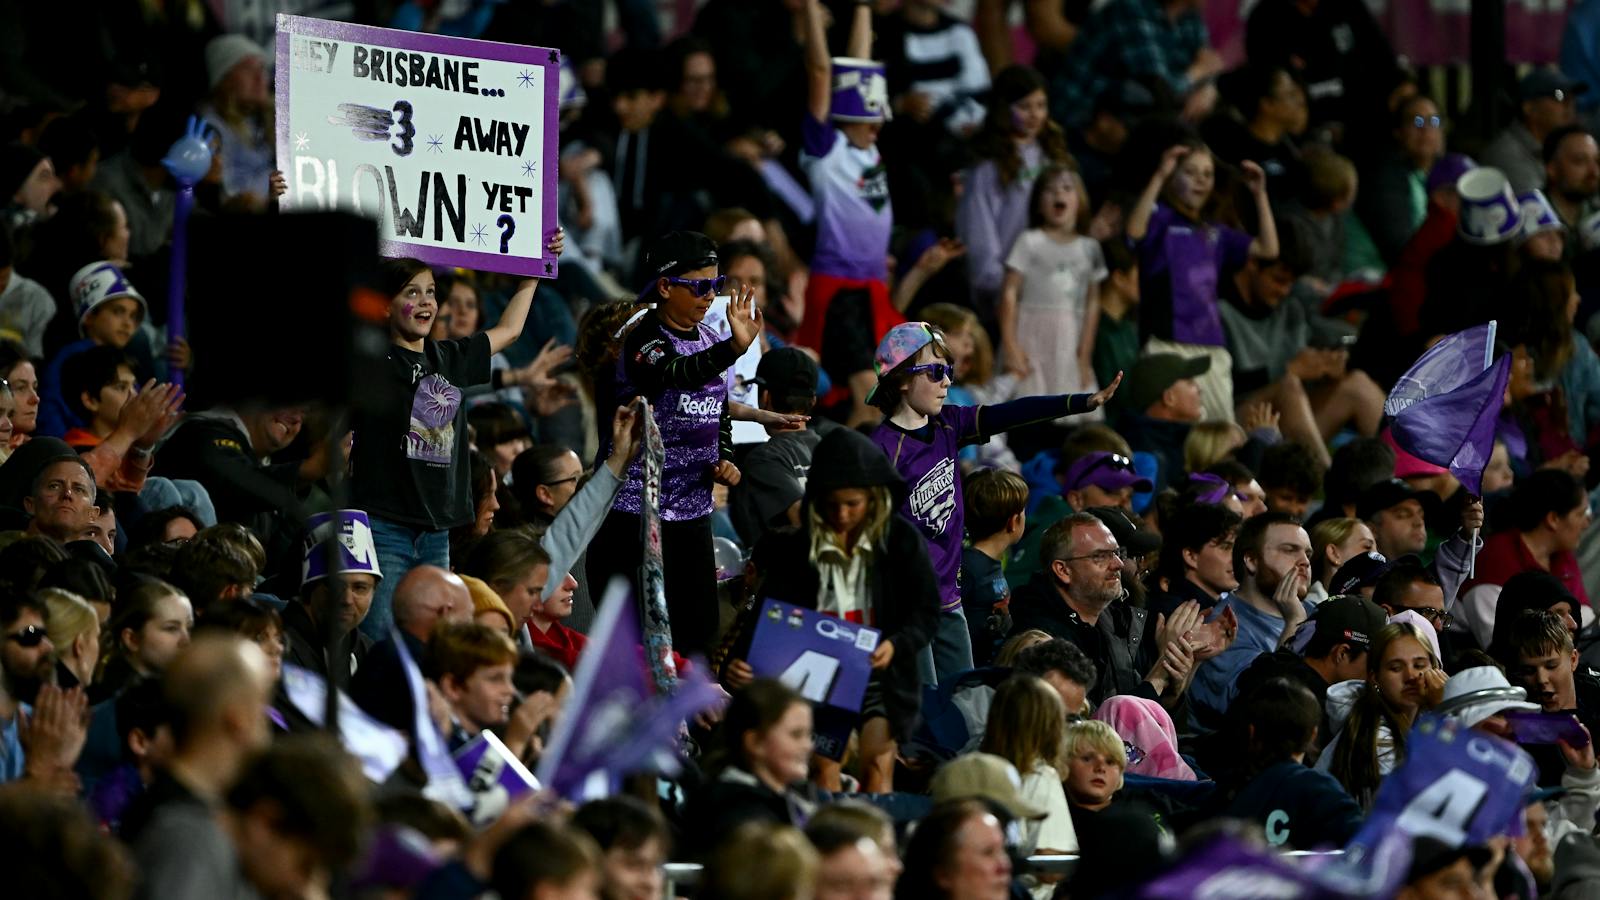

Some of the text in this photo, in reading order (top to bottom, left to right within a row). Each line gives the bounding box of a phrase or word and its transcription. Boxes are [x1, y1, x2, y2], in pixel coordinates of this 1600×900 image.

[294, 39, 338, 74] HEY
[453, 115, 530, 157] AWAY
[481, 180, 533, 214] YET
[496, 213, 516, 254] ?
[1265, 808, 1290, 846] C
